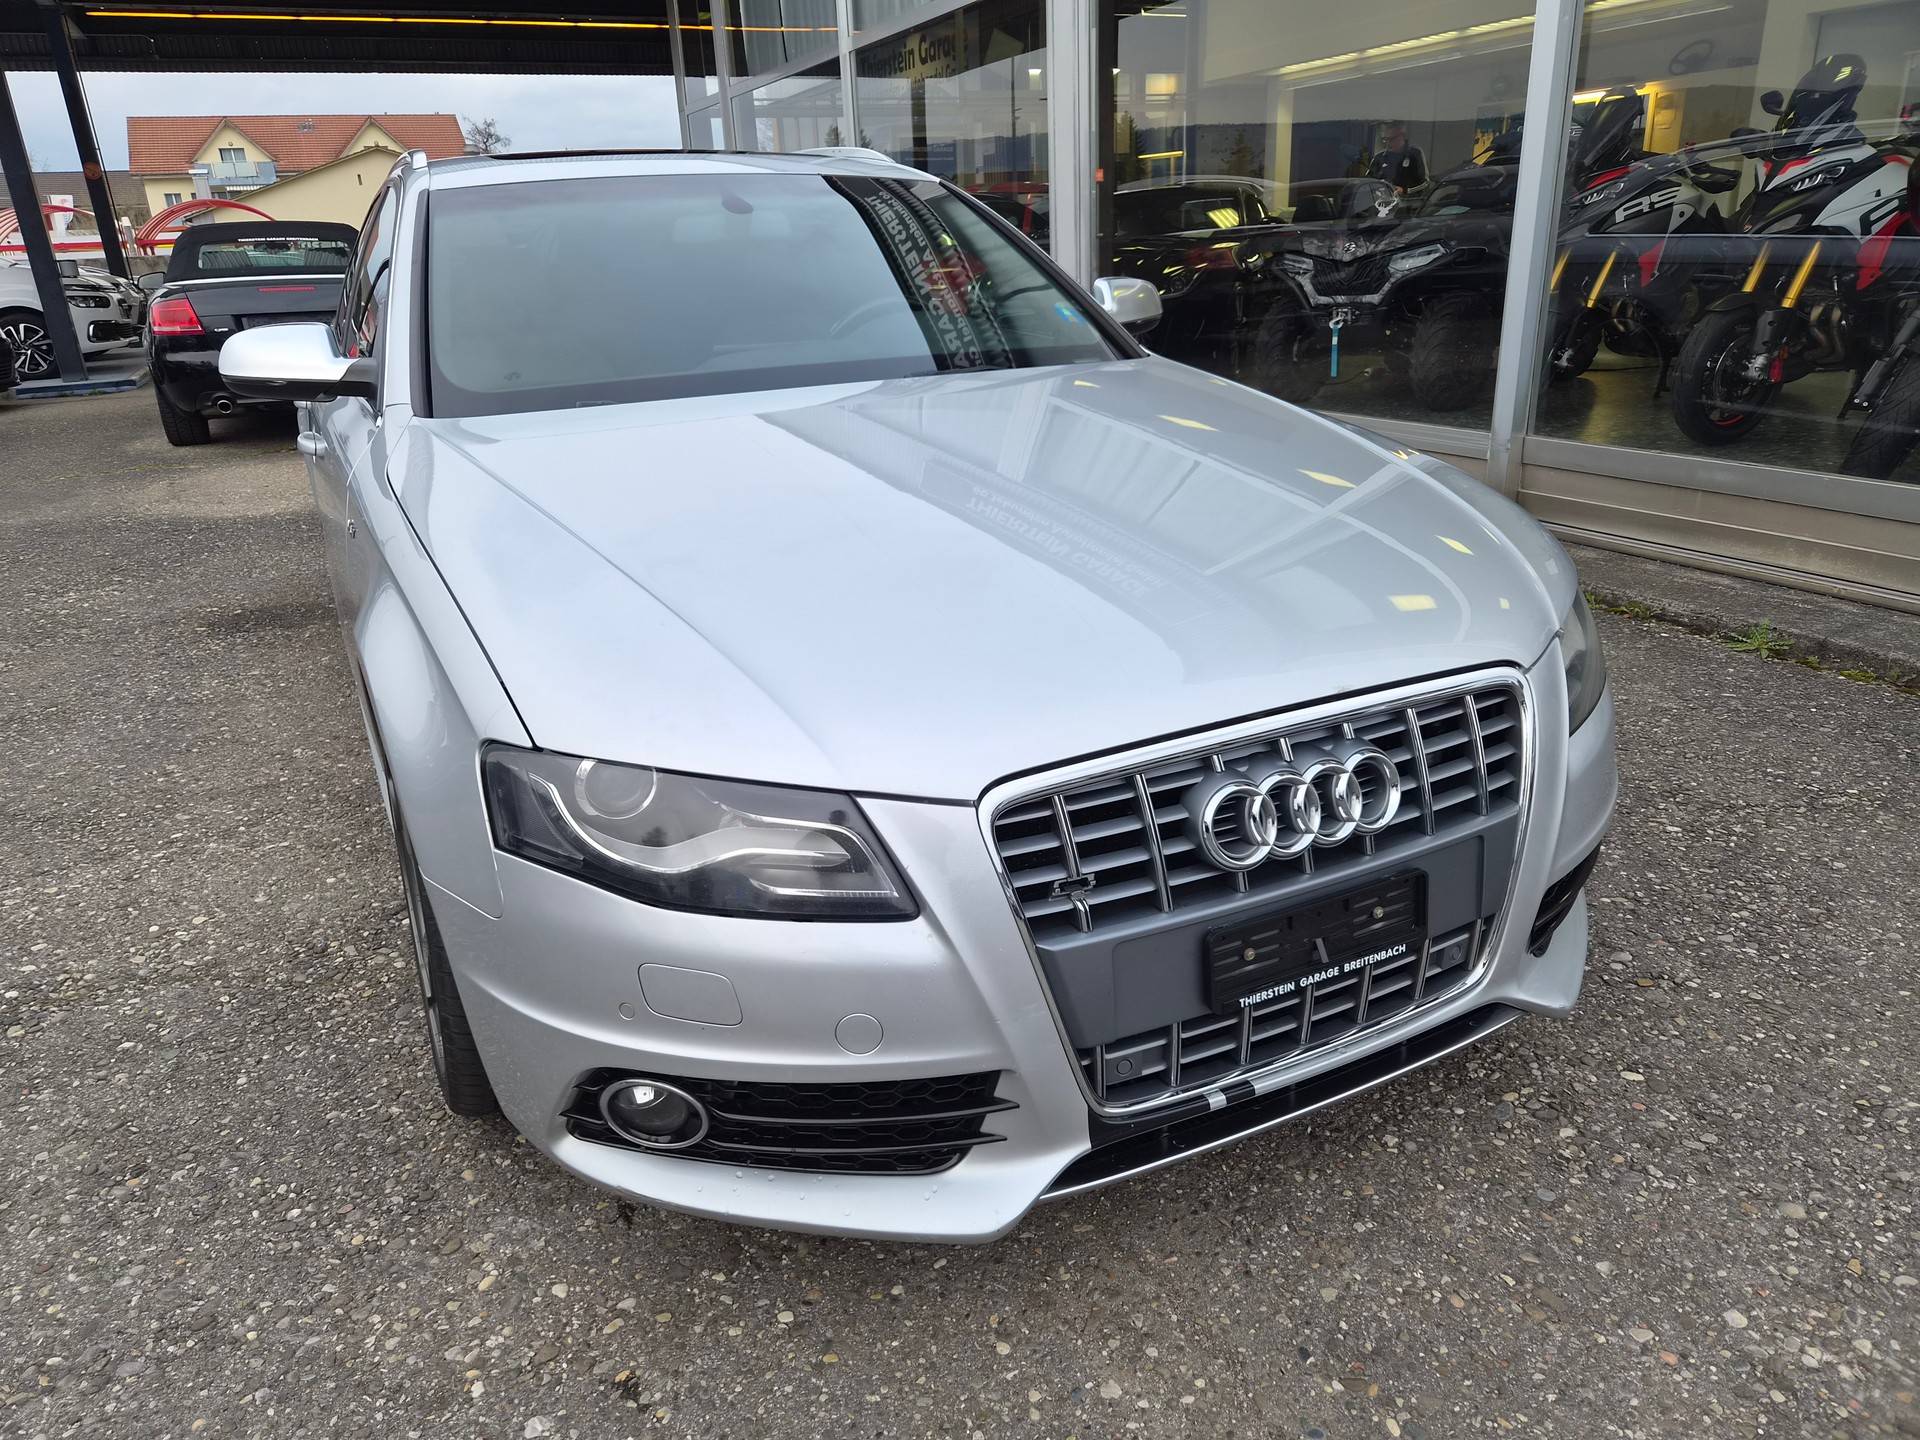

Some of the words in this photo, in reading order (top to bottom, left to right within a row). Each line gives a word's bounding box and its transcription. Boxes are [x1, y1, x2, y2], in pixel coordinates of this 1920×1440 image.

[1615, 187, 1682, 223] RS
[1239, 982, 1295, 1008] THIERSTEIN
[1299, 966, 1340, 988] GARAGE
[1343, 943, 1407, 973] BREITENBACH
